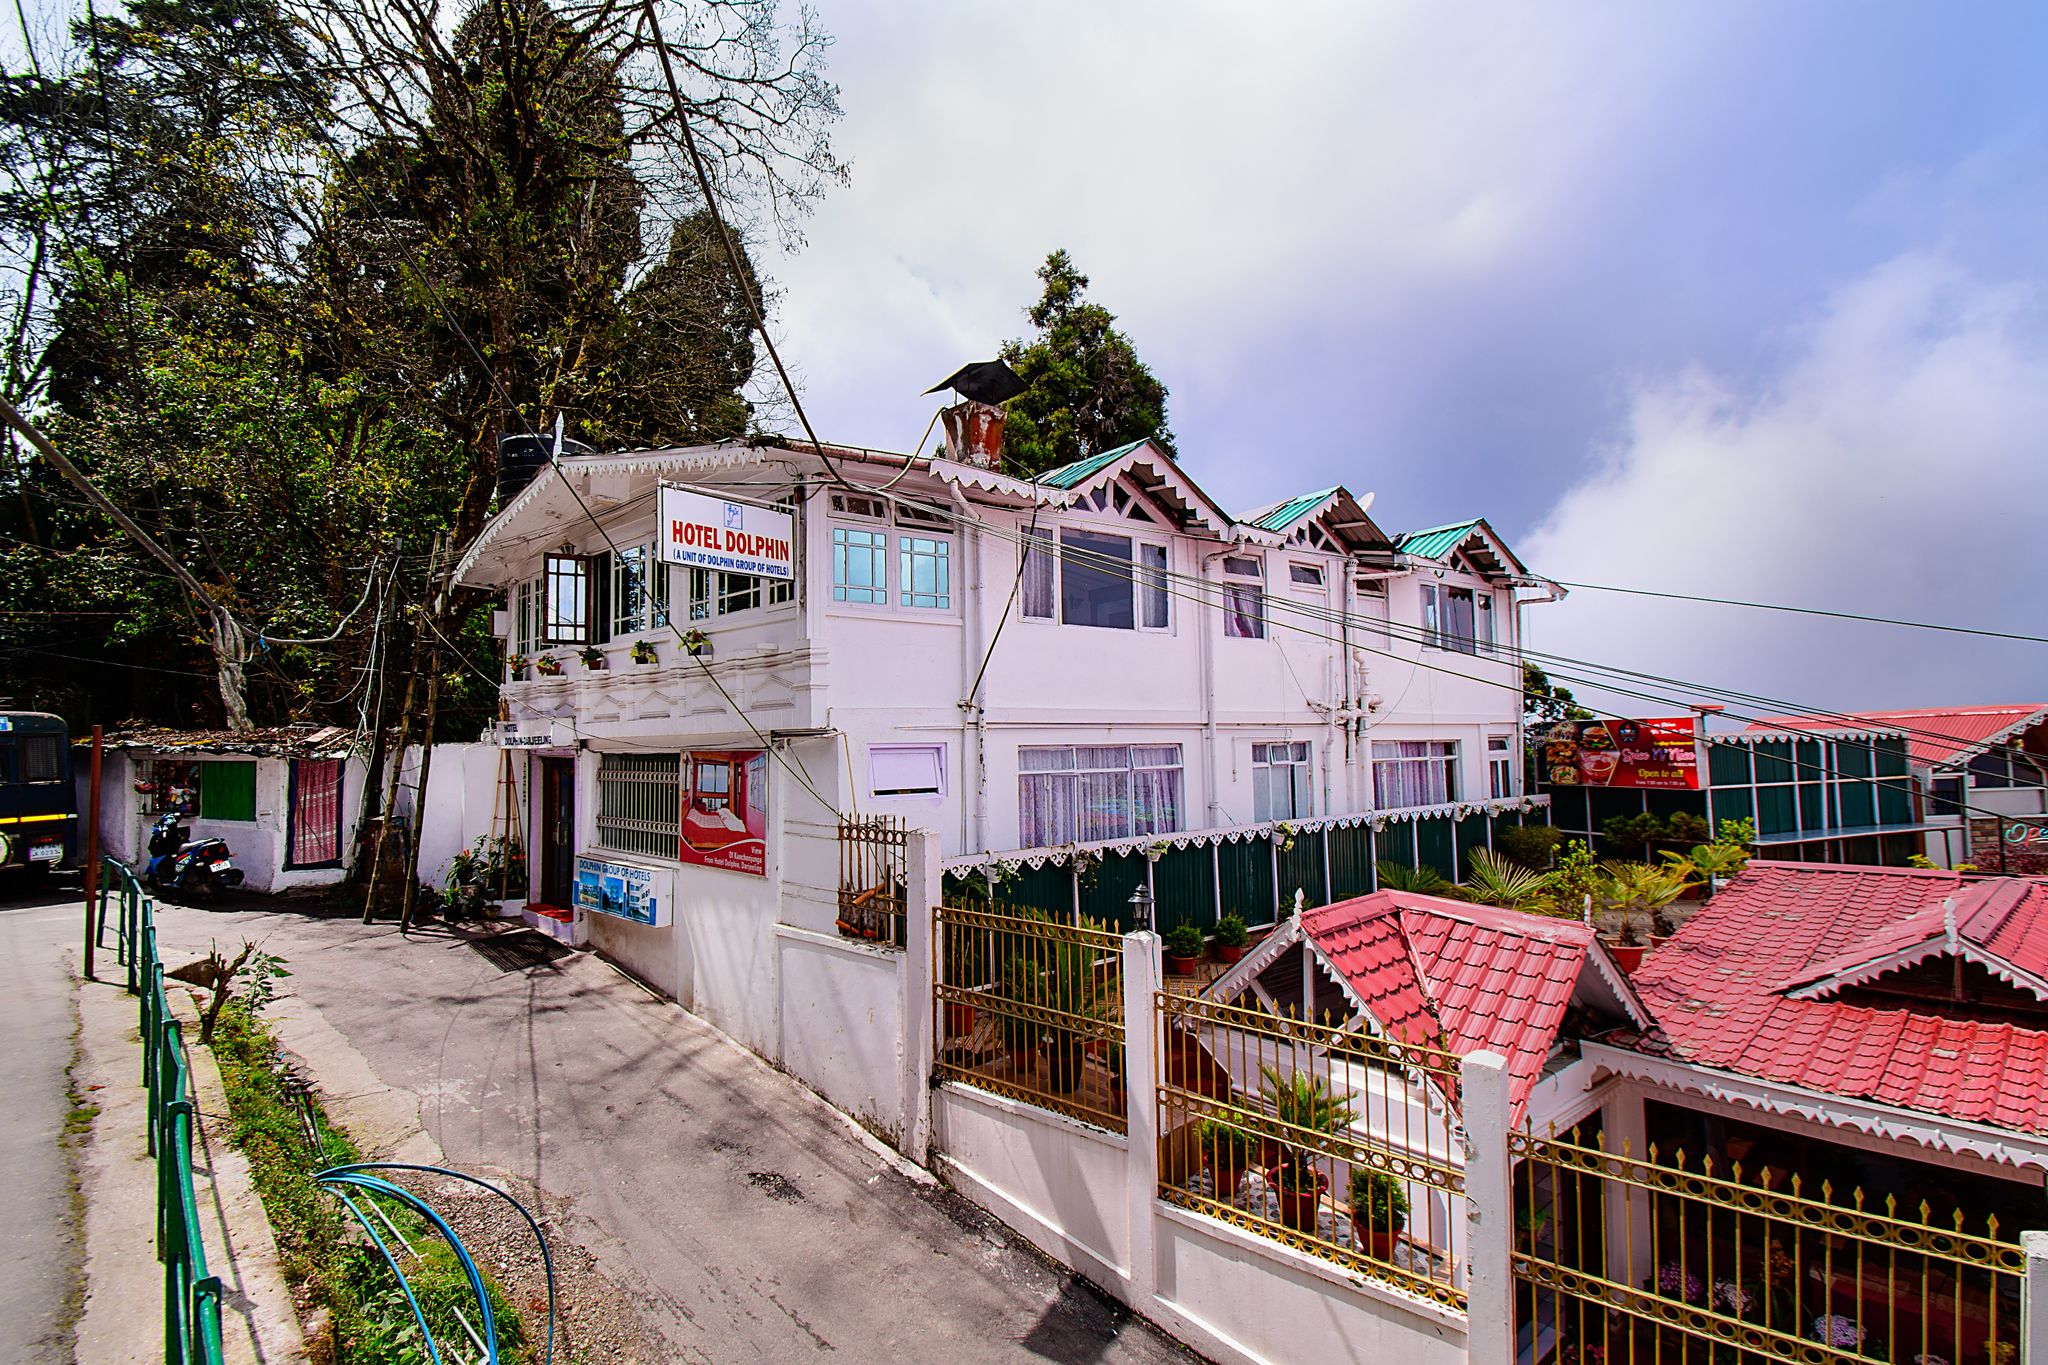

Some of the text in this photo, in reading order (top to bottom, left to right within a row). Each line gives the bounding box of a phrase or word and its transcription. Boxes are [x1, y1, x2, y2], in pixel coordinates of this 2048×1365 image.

[672, 520, 789, 561] HOTEL DOLPHIN
[682, 551, 697, 562] UNIT
[698, 554, 706, 564] OF
[707, 555, 735, 569] DOLPHIN
[735, 558, 756, 571] GROUP
[757, 563, 765, 573] OF
[766, 564, 789, 577] HOTELS)
[1638, 768, 1660, 779] Open
[580, 859, 651, 882] DOLPHIN GROUP OF HOTELS
